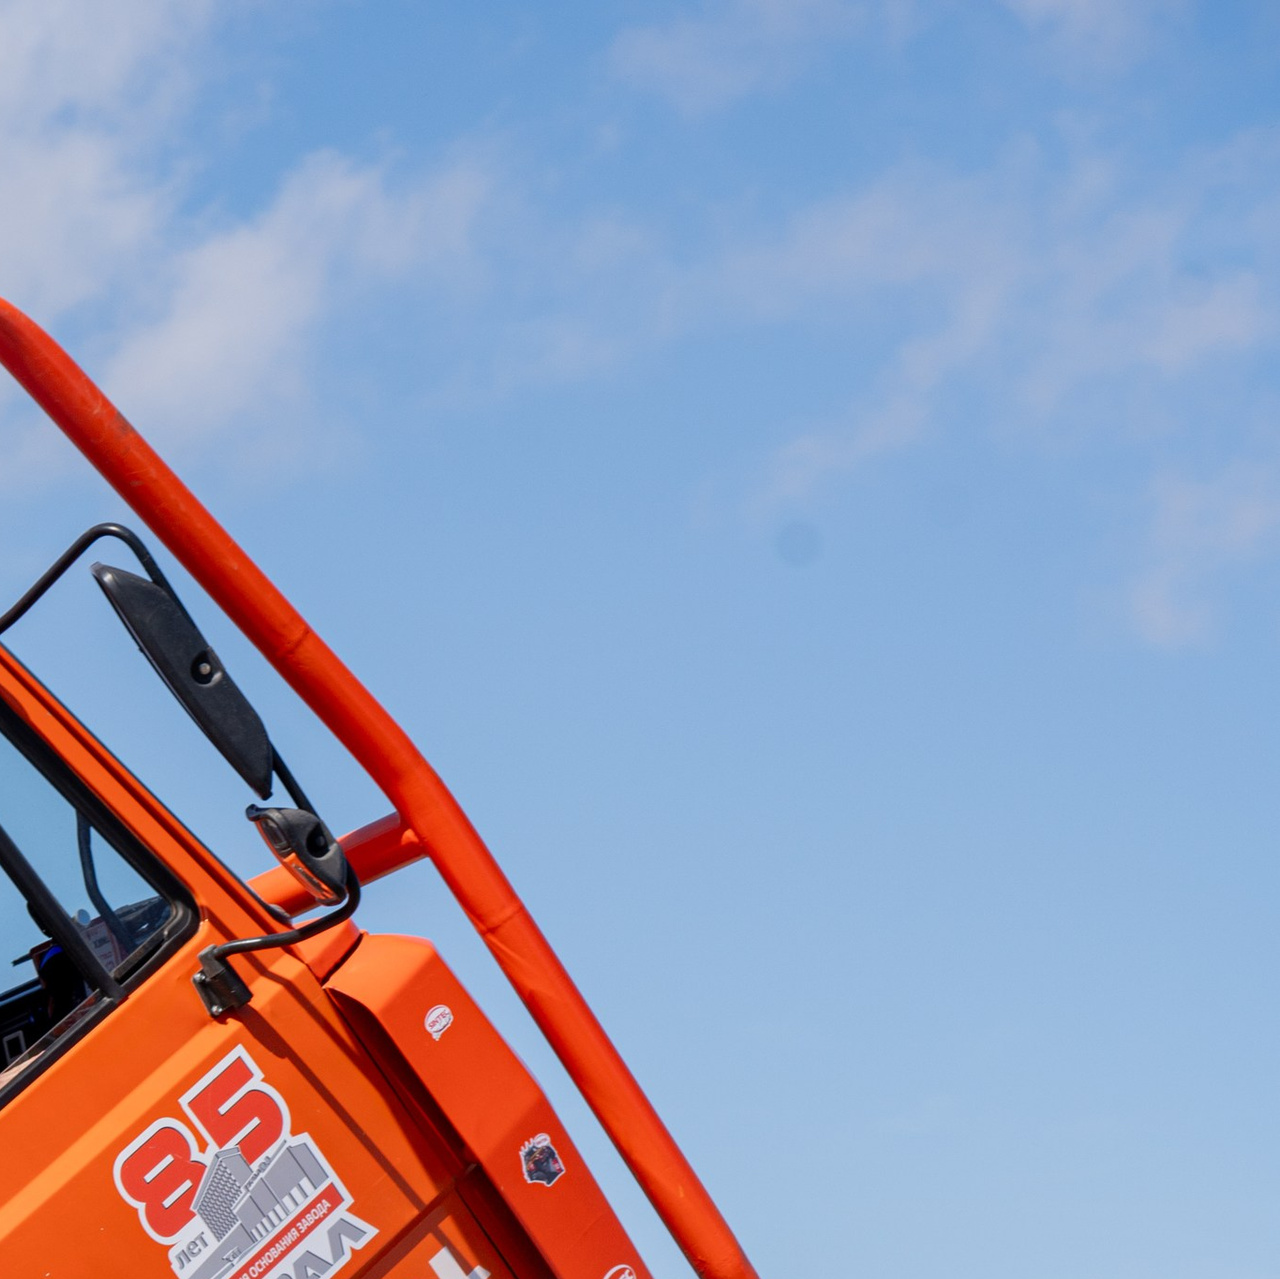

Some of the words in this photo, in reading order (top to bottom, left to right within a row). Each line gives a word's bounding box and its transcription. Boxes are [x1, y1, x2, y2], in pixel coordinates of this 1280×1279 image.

[120, 1054, 287, 1240] 85
[174, 1231, 209, 1270] лет
[249, 1227, 299, 1277] ОСНОВАНИЯ
[296, 1199, 332, 1232] ЗАВОДА
